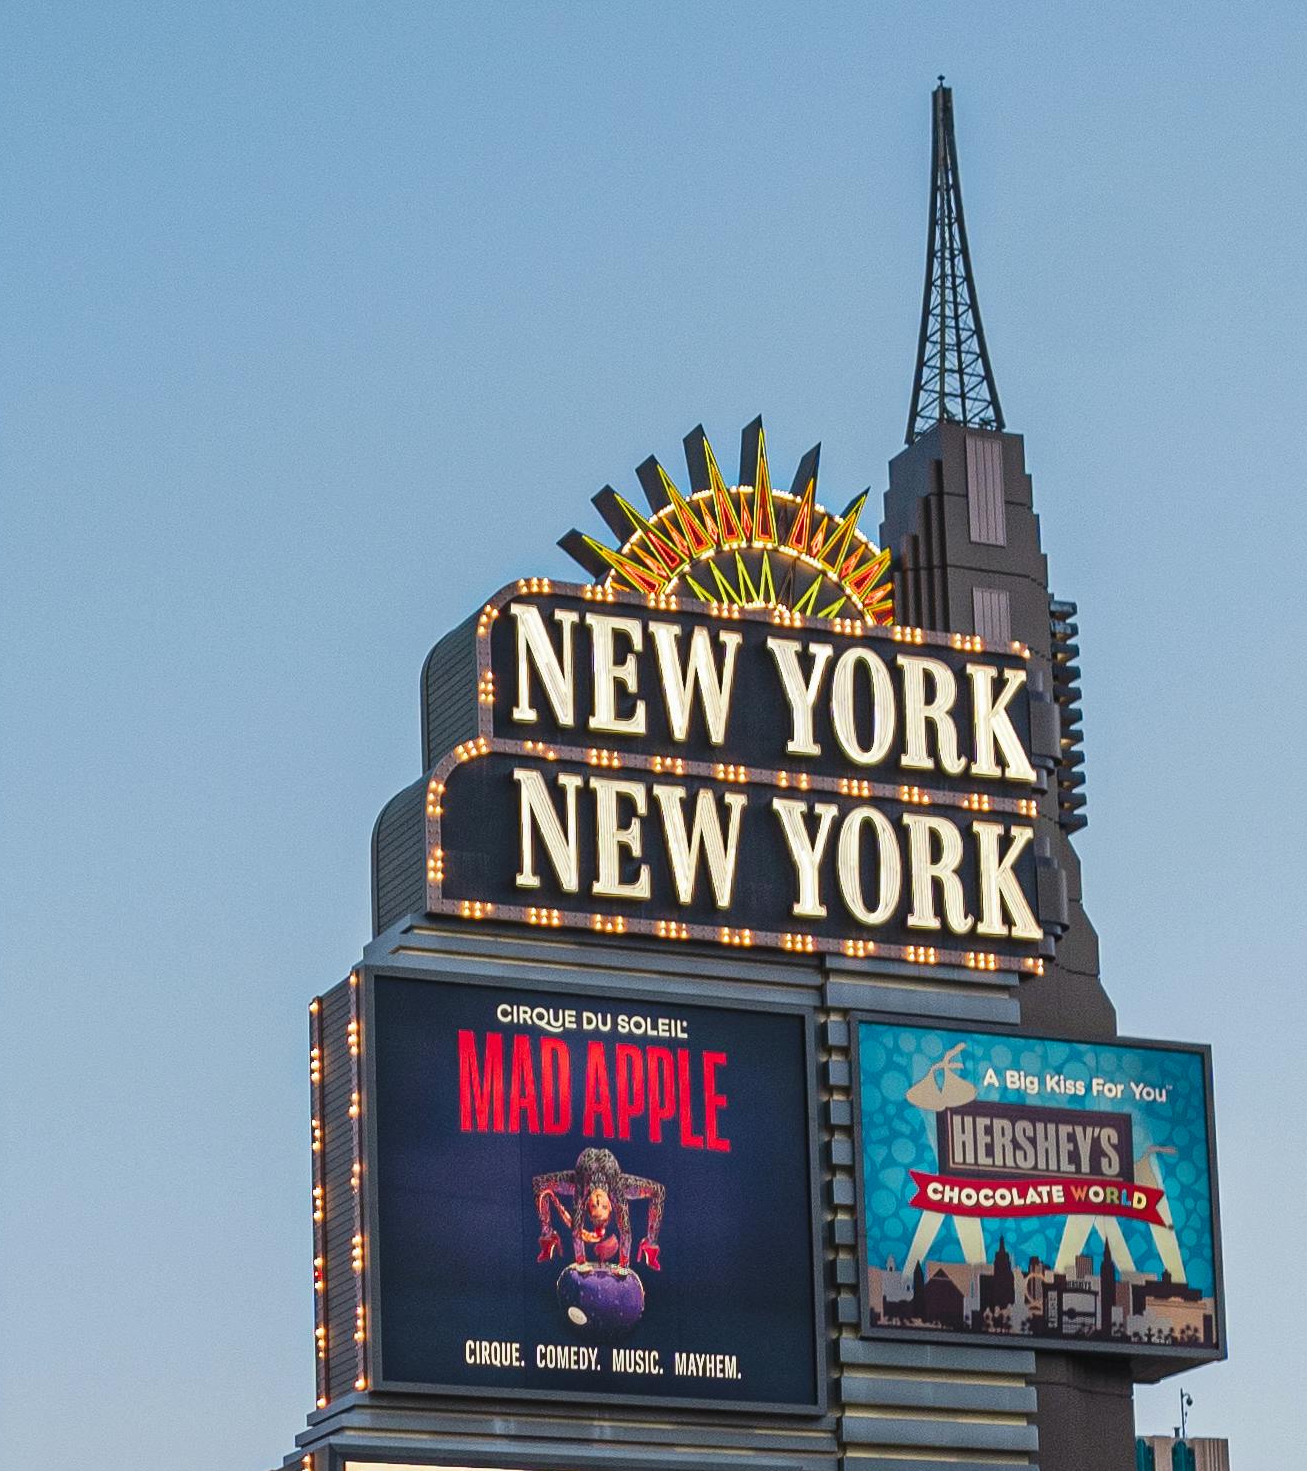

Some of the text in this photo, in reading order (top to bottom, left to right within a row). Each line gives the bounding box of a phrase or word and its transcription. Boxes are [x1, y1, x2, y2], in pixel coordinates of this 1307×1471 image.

[509, 602, 1039, 784] NEW YORK
[512, 768, 1044, 942] NEW YORK
[496, 1003, 577, 1034] CIRQUE
[582, 1011, 612, 1032] DU
[458, 1029, 731, 1153] MAD APPLE
[982, 1068, 1168, 1104] A Big Kiss For You
[951, 1112, 1121, 1177] HERSHEY'S
[926, 1181, 1148, 1211] CHOCOLATE WORLD
[465, 1339, 742, 1381] CIRQUE. COMEDY. MUSIC. MAYHEM.
